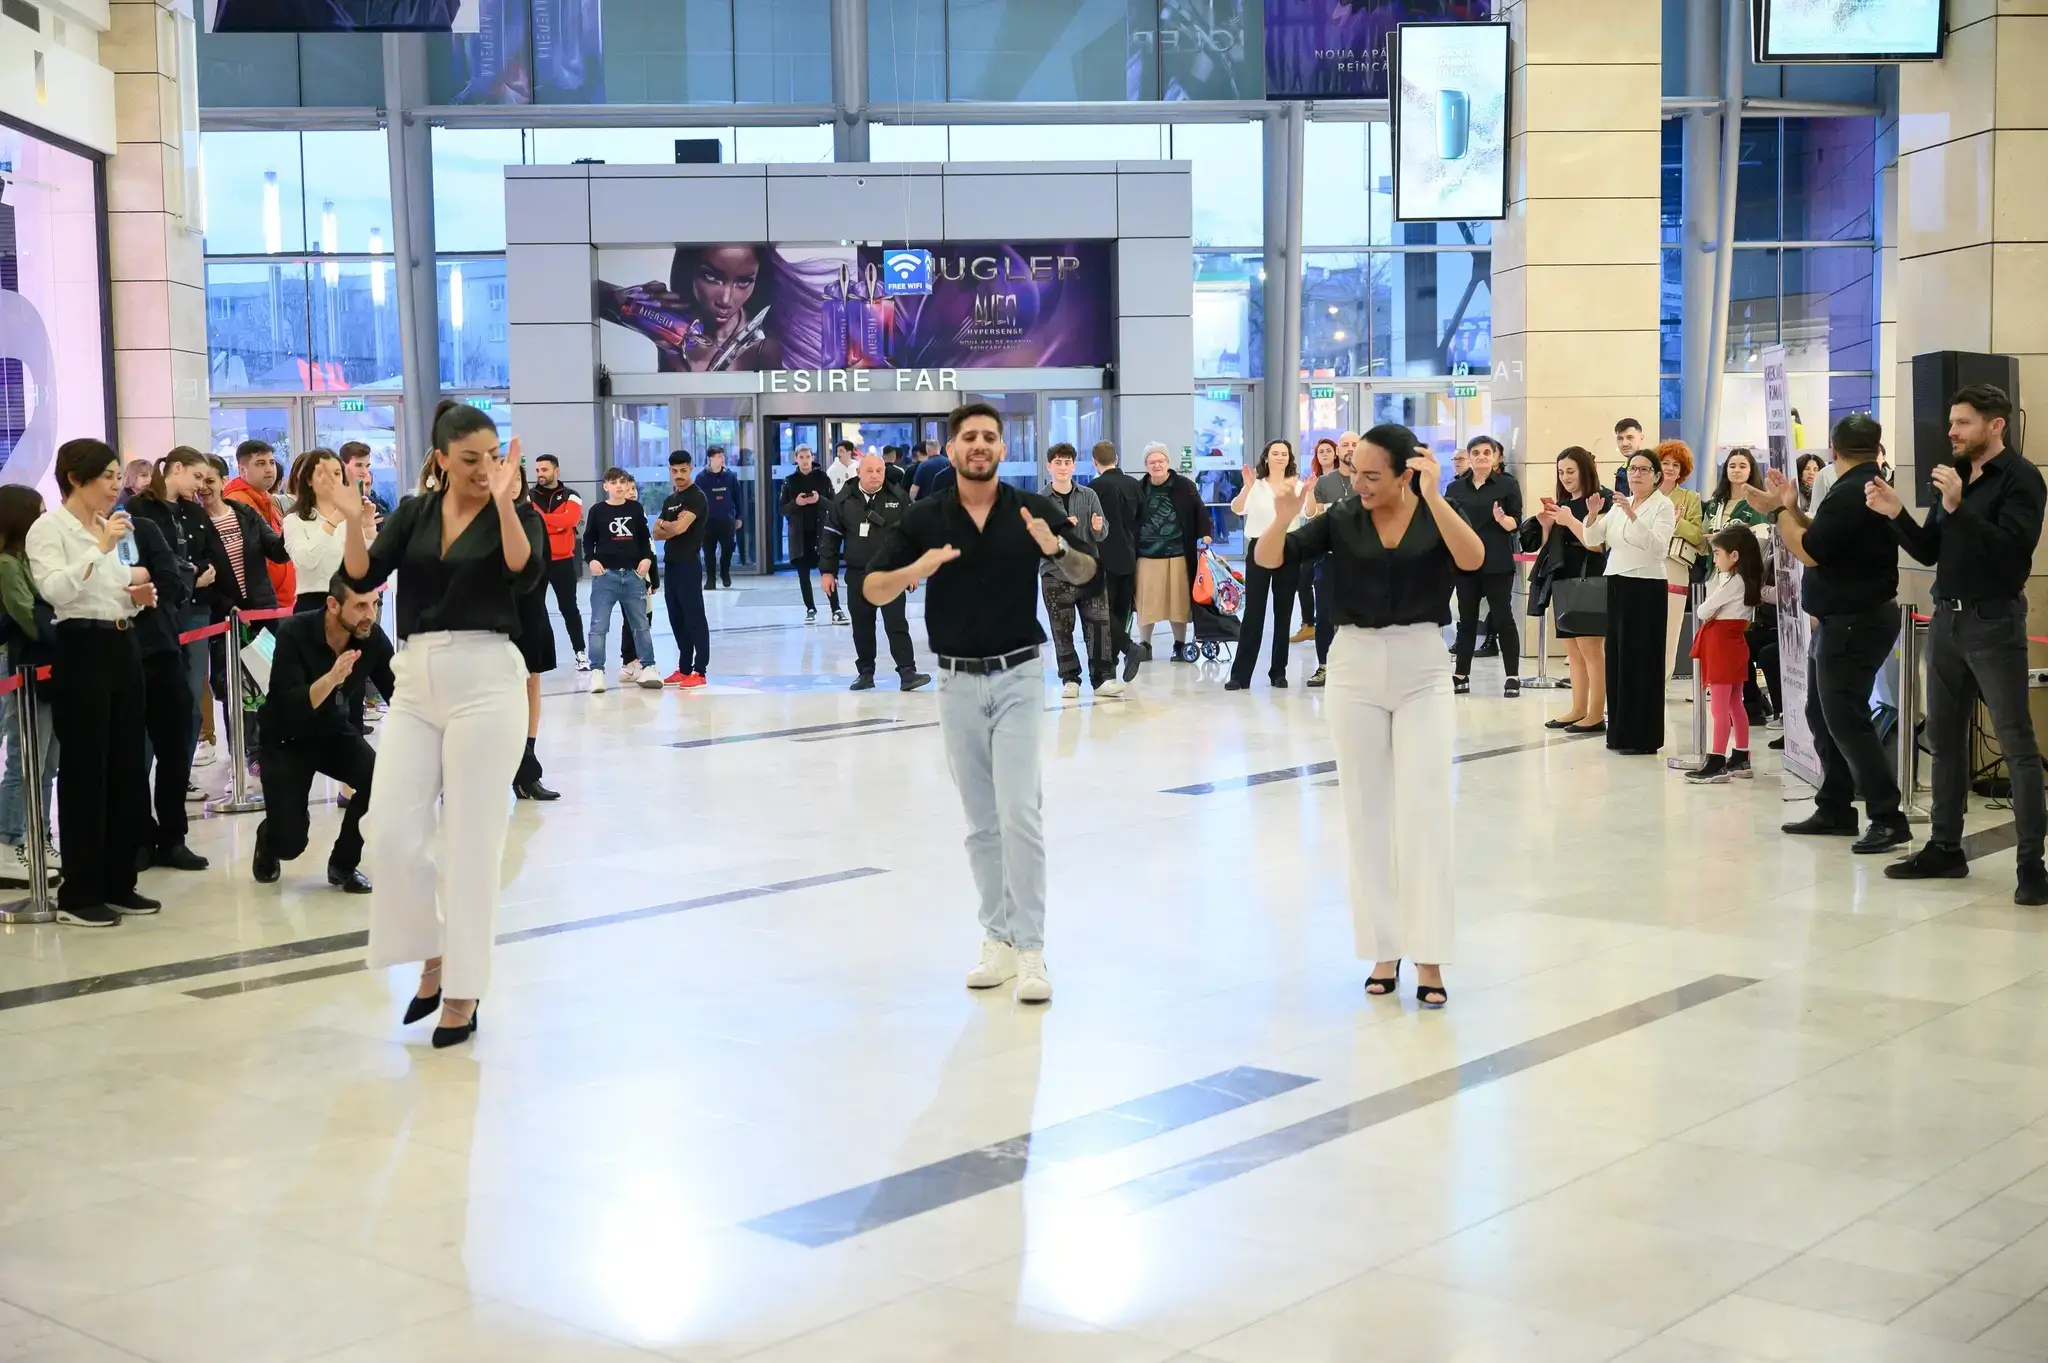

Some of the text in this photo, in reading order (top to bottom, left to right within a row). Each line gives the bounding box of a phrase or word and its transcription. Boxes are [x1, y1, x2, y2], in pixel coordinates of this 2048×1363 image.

[1314, 49, 1354, 59] NOUA
[759, 368, 958, 393] IESIRE FAR
[1207, 389, 1229, 399] EXIT
[1311, 388, 1333, 397] EXIT
[1454, 387, 1476, 396] EXIT
[339, 401, 363, 411] EXIT
